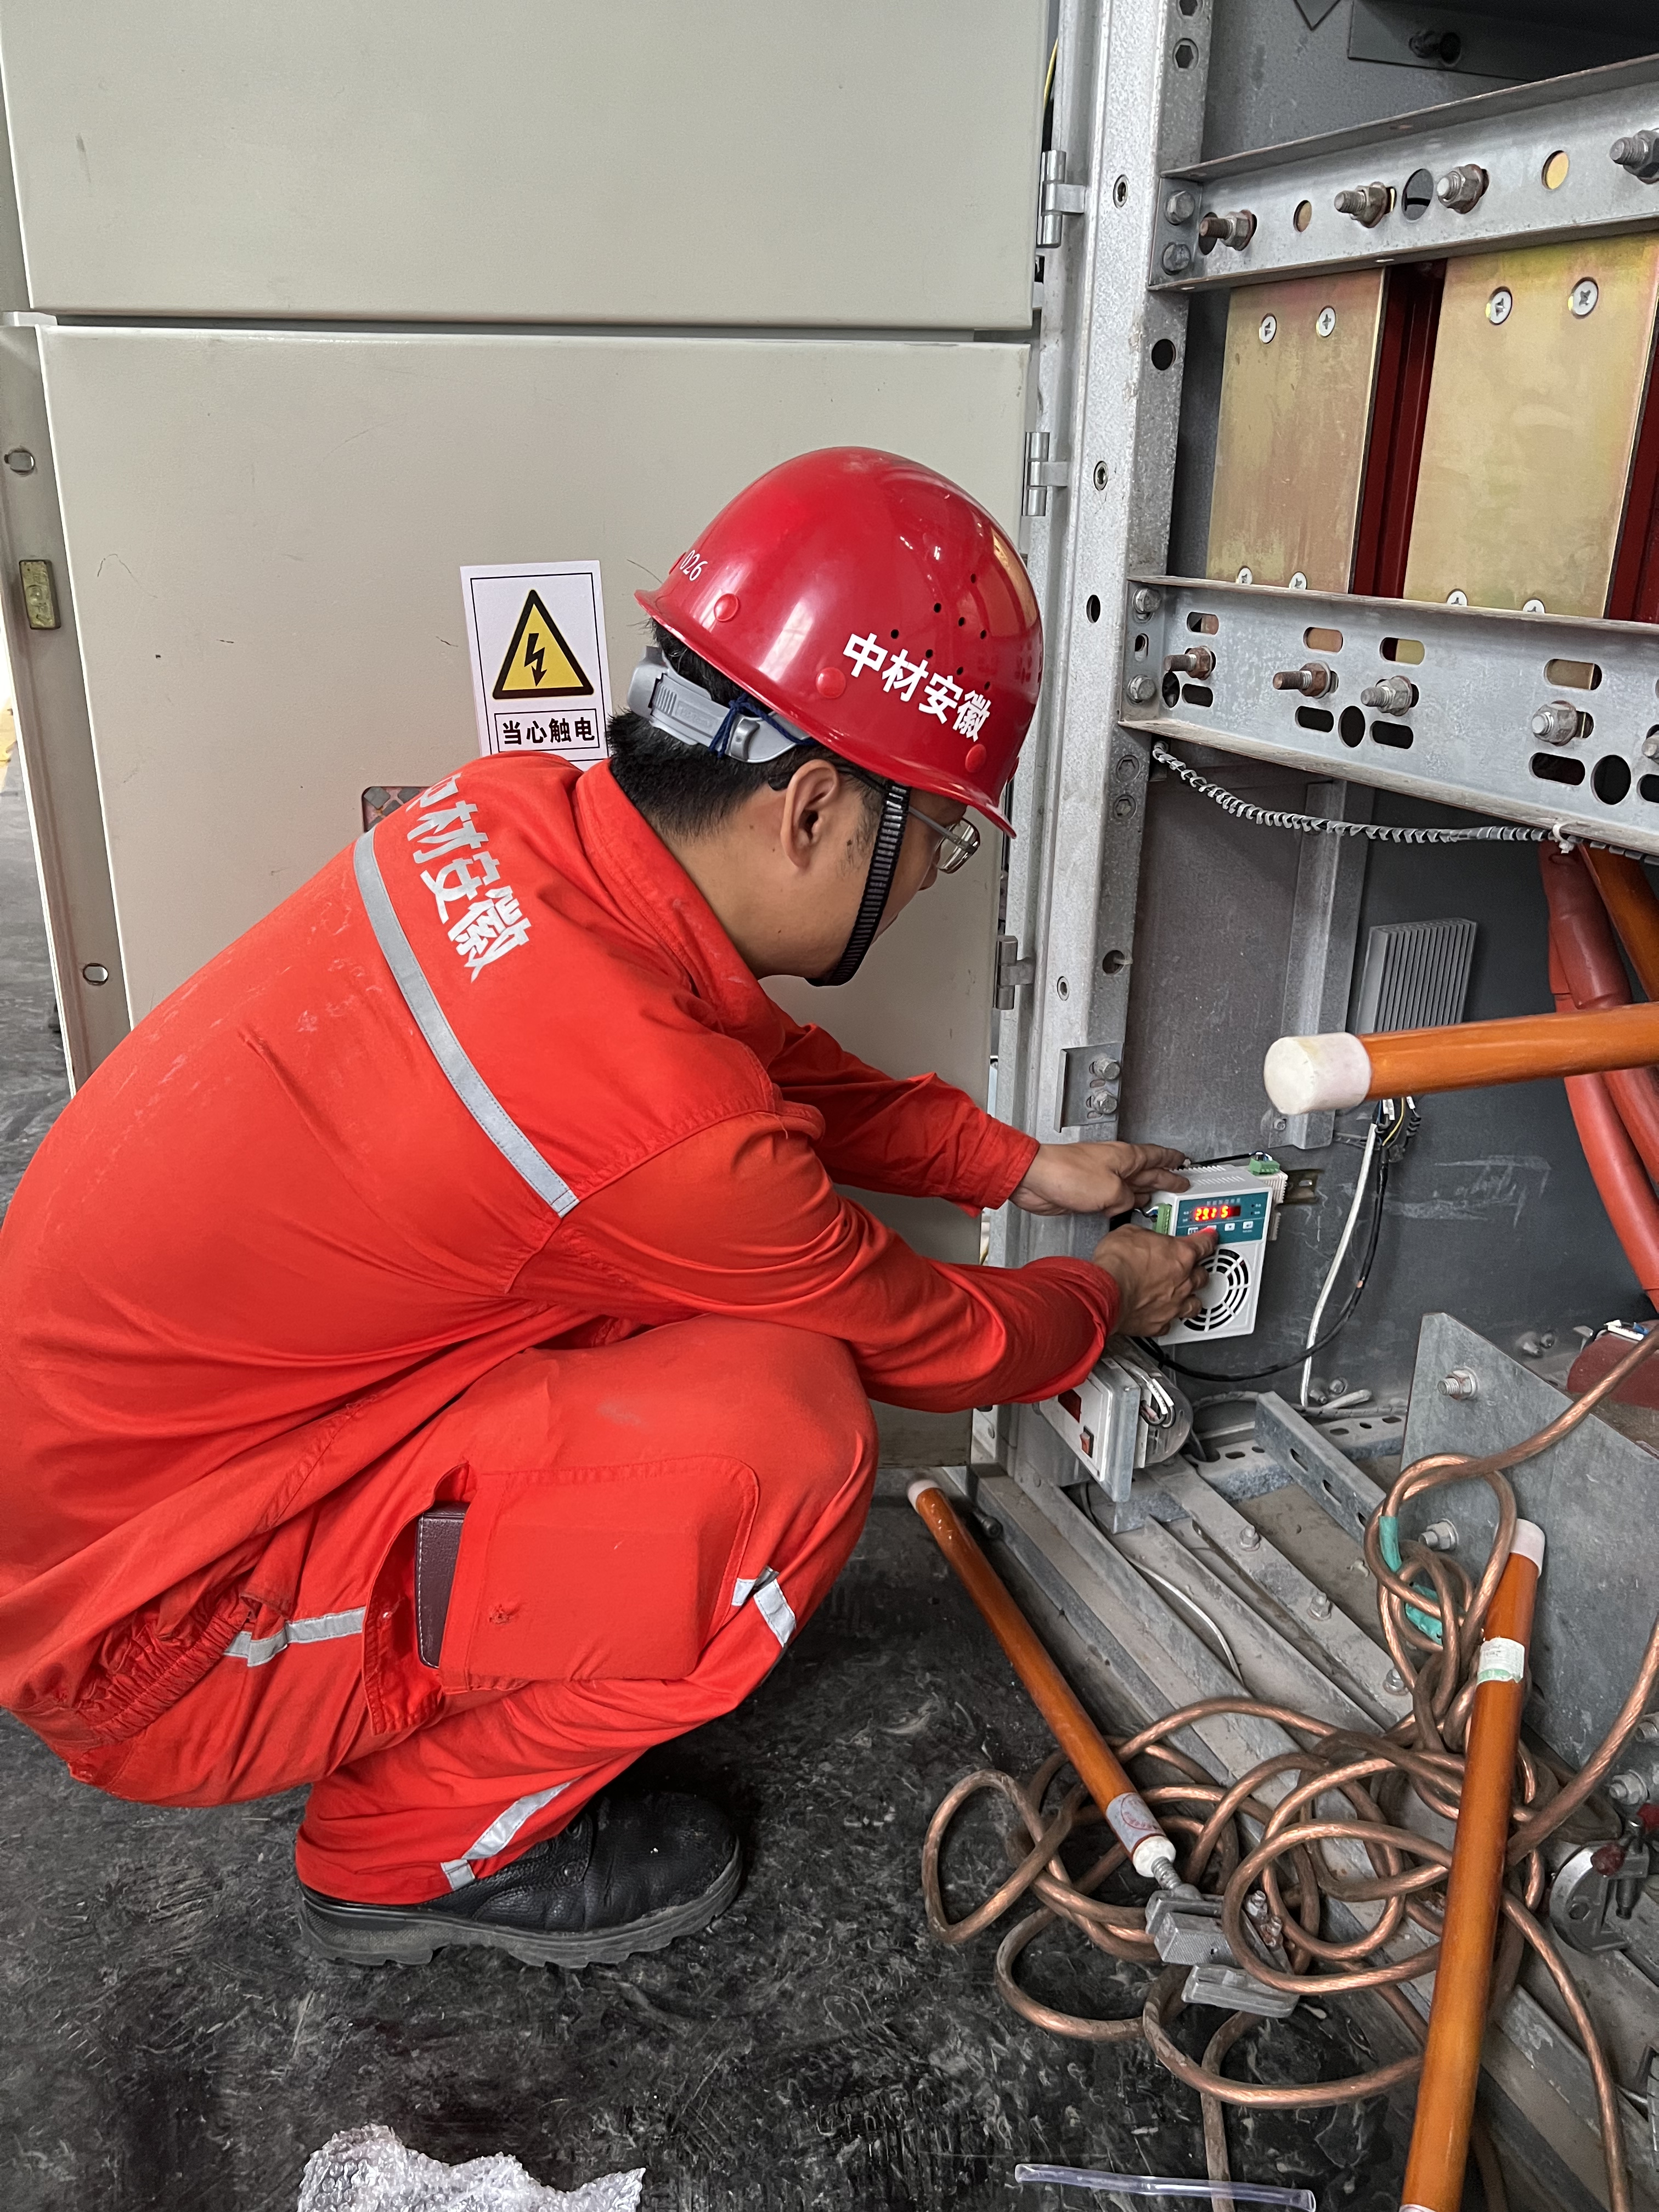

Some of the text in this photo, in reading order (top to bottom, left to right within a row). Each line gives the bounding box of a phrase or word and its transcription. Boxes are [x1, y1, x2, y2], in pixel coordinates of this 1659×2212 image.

[680, 549, 708, 581] 026
[842, 632, 991, 742] 中材安徽
[502, 716, 595, 745] 当心触电
